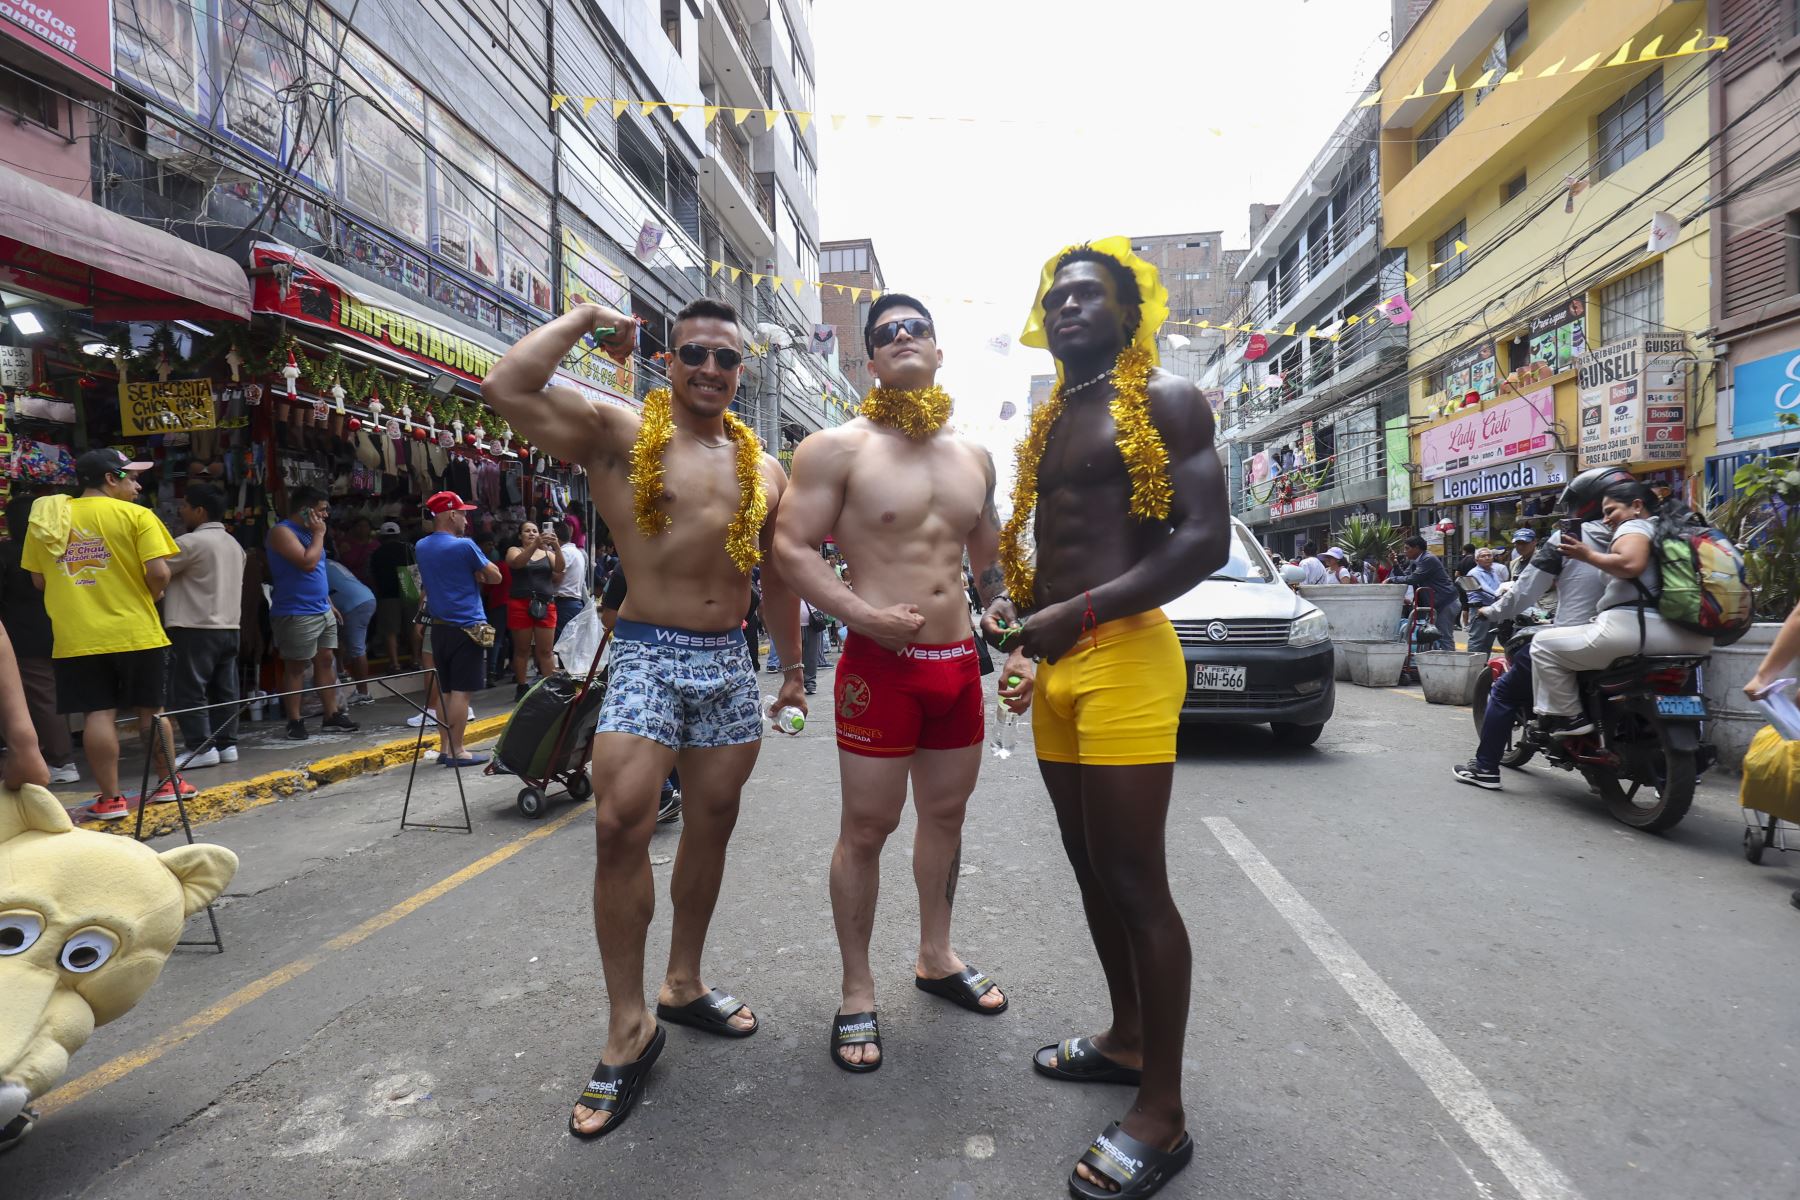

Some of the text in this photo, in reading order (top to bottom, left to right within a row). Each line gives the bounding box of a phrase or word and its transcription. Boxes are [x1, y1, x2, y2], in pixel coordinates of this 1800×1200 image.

[340, 297, 500, 381] IMPORTACION
[1578, 338, 1638, 366] DISTRIBUIDORA
[2, 359, 13, 367] AL
[1578, 350, 1638, 390] GUISELL
[128, 381, 212, 401] SE NECESITA
[1612, 386, 1635, 400] Boston
[132, 400, 171, 417] CHICA
[1651, 409, 1680, 419] Boston
[132, 413, 193, 432] VENTAS
[1448, 409, 1511, 453] Lady Cielo
[1585, 443, 1607, 454] America
[1608, 440, 1619, 450] 334
[1586, 448, 1631, 465] PASE AL FONDO
[1442, 463, 1534, 499] Lencimoda
[1547, 474, 1560, 484] 336
[78, 546, 104, 555] Chau
[1196, 671, 1244, 688] BNH-566
[843, 731, 872, 743] LIMITADA
